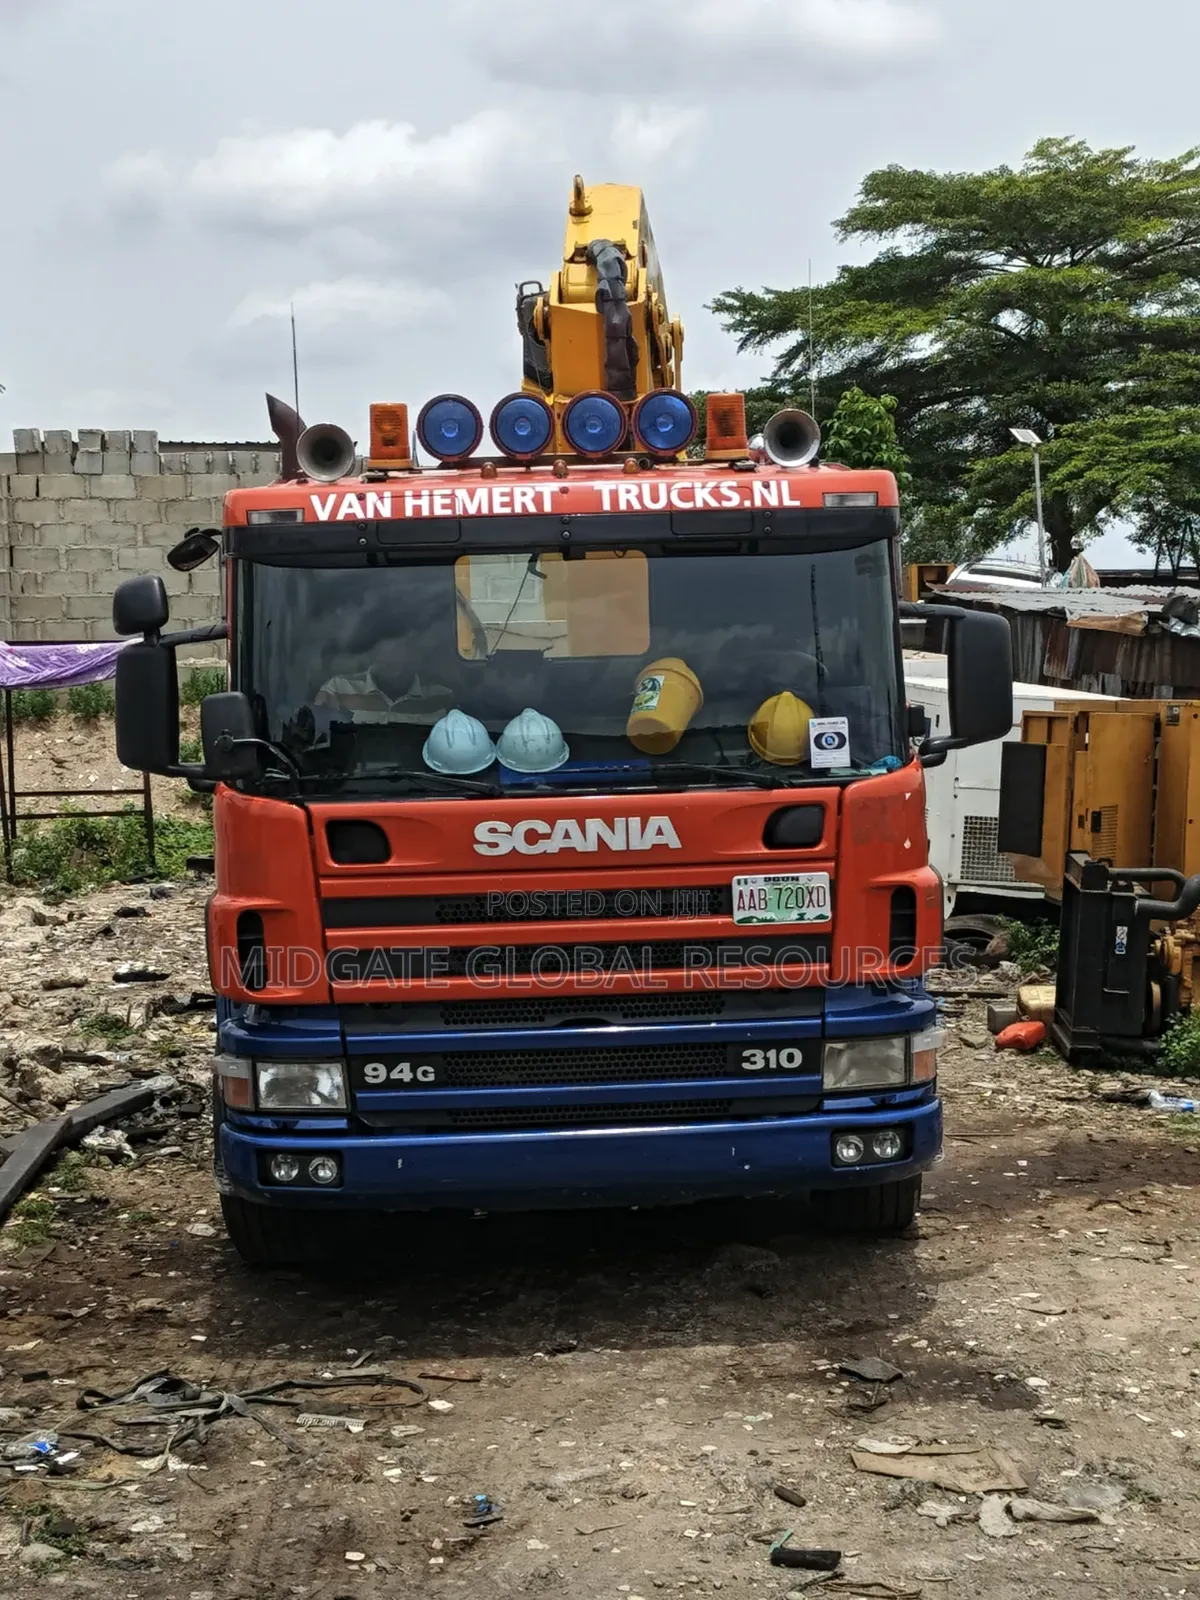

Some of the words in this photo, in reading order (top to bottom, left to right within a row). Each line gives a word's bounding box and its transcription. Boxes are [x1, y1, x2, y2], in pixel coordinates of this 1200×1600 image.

[310, 491, 392, 521] VAN
[405, 483, 555, 516] HEMERT
[594, 480, 801, 511] TRUCKS.NL
[473, 816, 682, 856] SCANIA
[363, 1062, 435, 1084] 94G
[741, 1048, 803, 1070] 310
